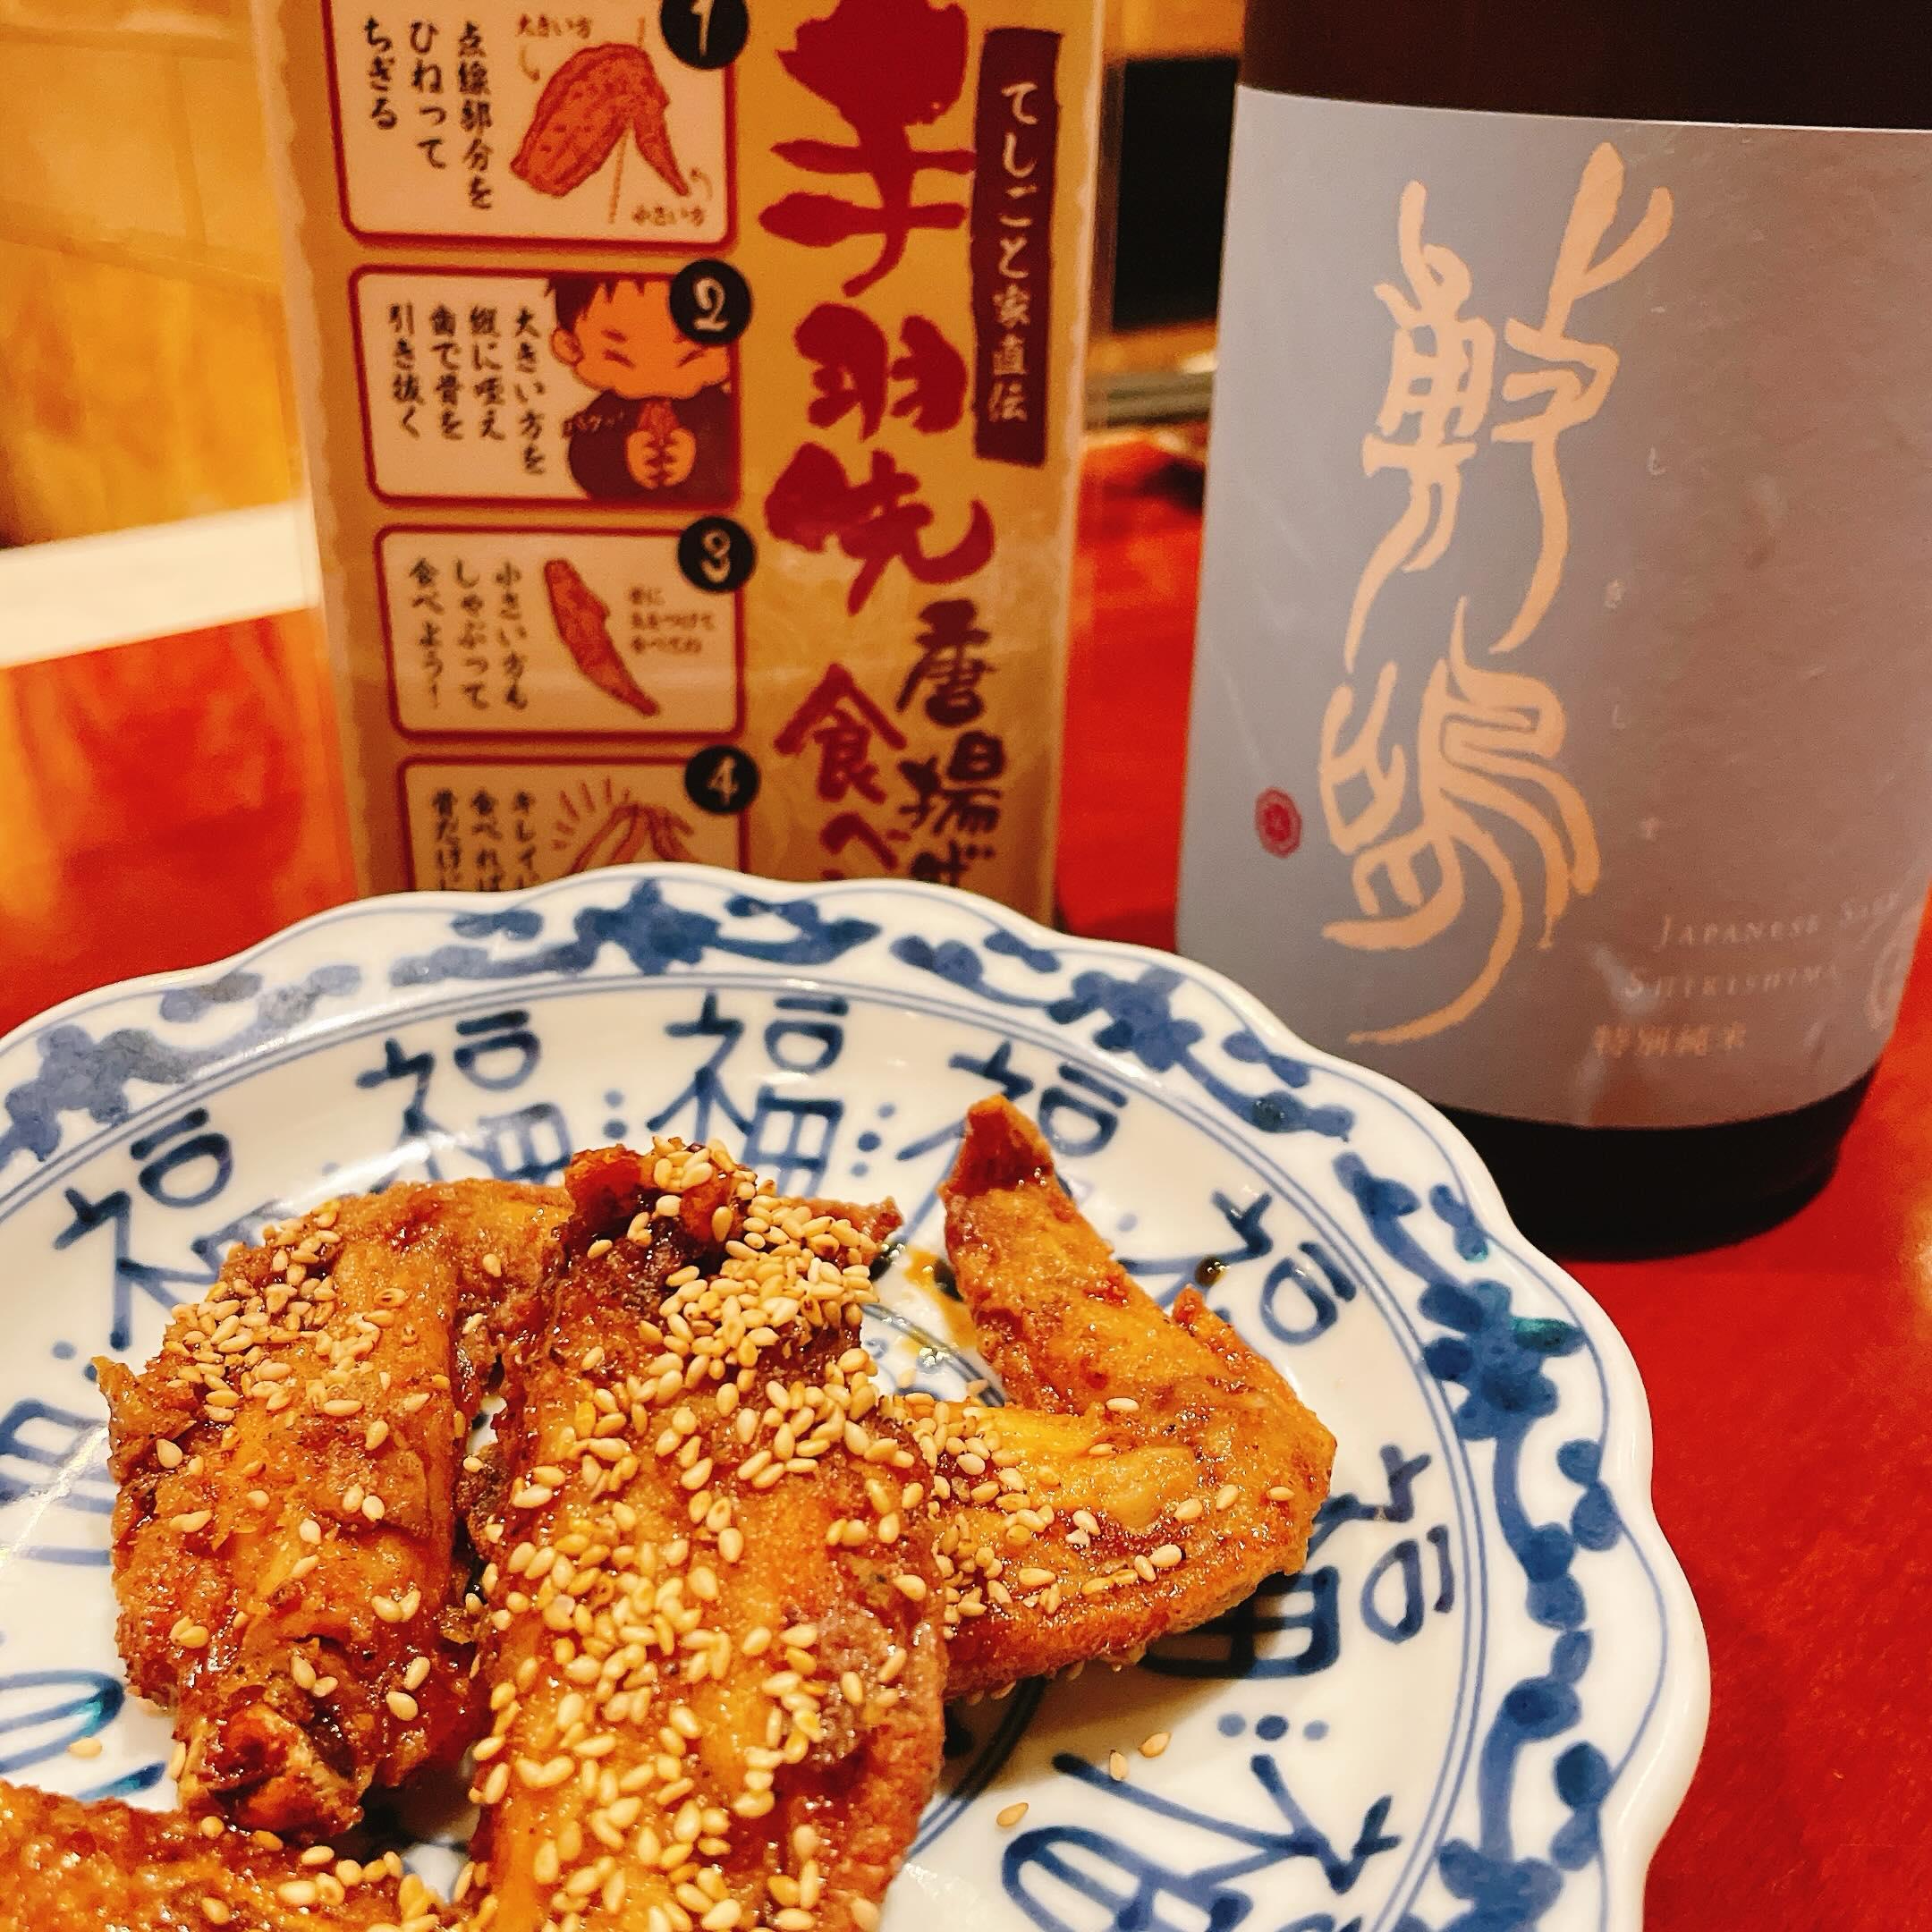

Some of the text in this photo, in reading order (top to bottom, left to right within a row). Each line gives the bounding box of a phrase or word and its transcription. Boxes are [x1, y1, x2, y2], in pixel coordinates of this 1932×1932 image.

[364, 14, 396, 130] ちぎる
[409, 21, 446, 170] ひねって
[457, 21, 493, 210] 点線部分を
[692, 275, 729, 331] 2
[988, 81, 1038, 423] てしごと家直伝
[389, 302, 422, 438] 引き抜く
[515, 306, 546, 474] 大きい方を
[701, 529, 731, 582] 3
[455, 558, 488, 710] しゃぶって
[496, 561, 528, 710] 小さい方も
[708, 757, 739, 805] 4
[773, 663, 911, 881] 食べ
